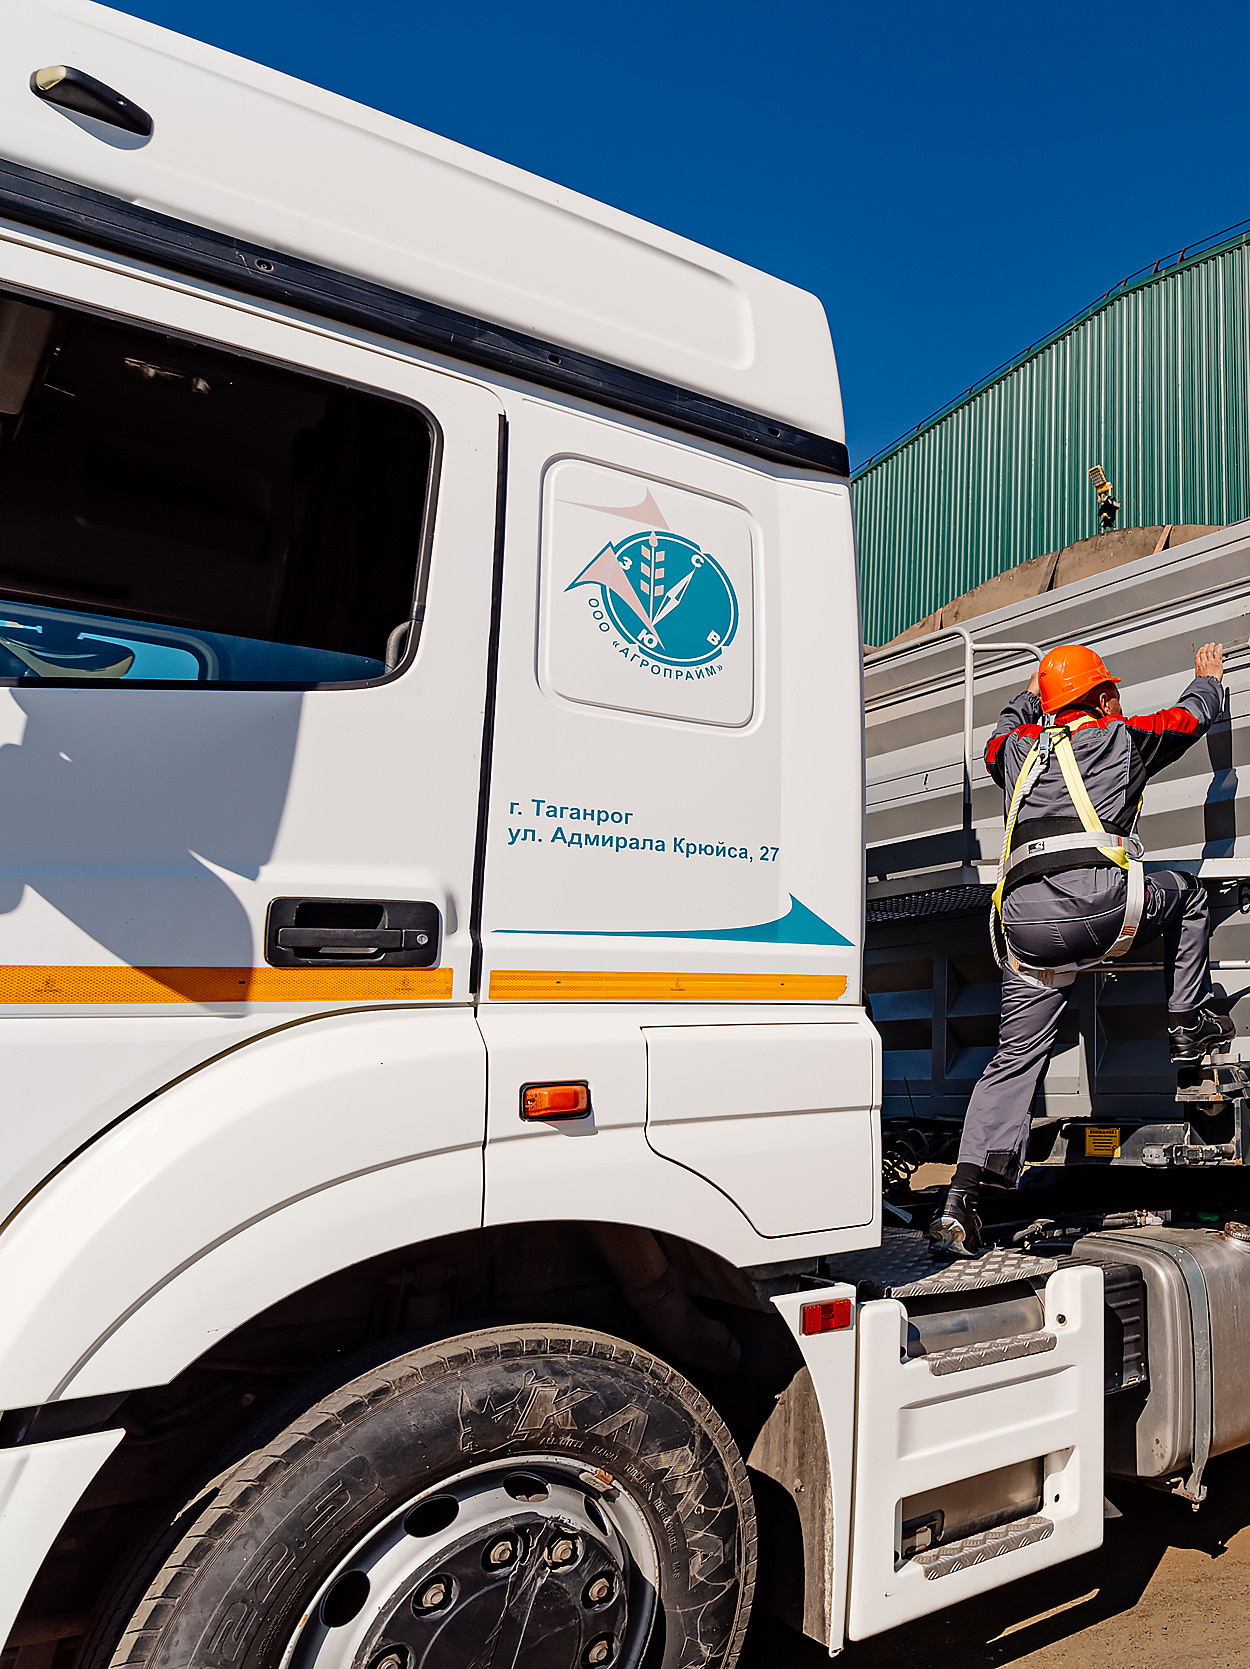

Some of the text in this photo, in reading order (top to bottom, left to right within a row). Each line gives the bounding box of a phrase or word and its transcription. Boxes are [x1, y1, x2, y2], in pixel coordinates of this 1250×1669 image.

[588, 598, 723, 680] ООО «АГРОПРАЙМ»
[507, 826, 780, 863] ул. Адмирала Крюйса, 27
[509, 798, 634, 826] г. Таганрог
[517, 1387, 724, 1591] KAMA
[591, 1444, 620, 1463] RADIAL
[653, 1497, 679, 1554] REGROOVABLE
